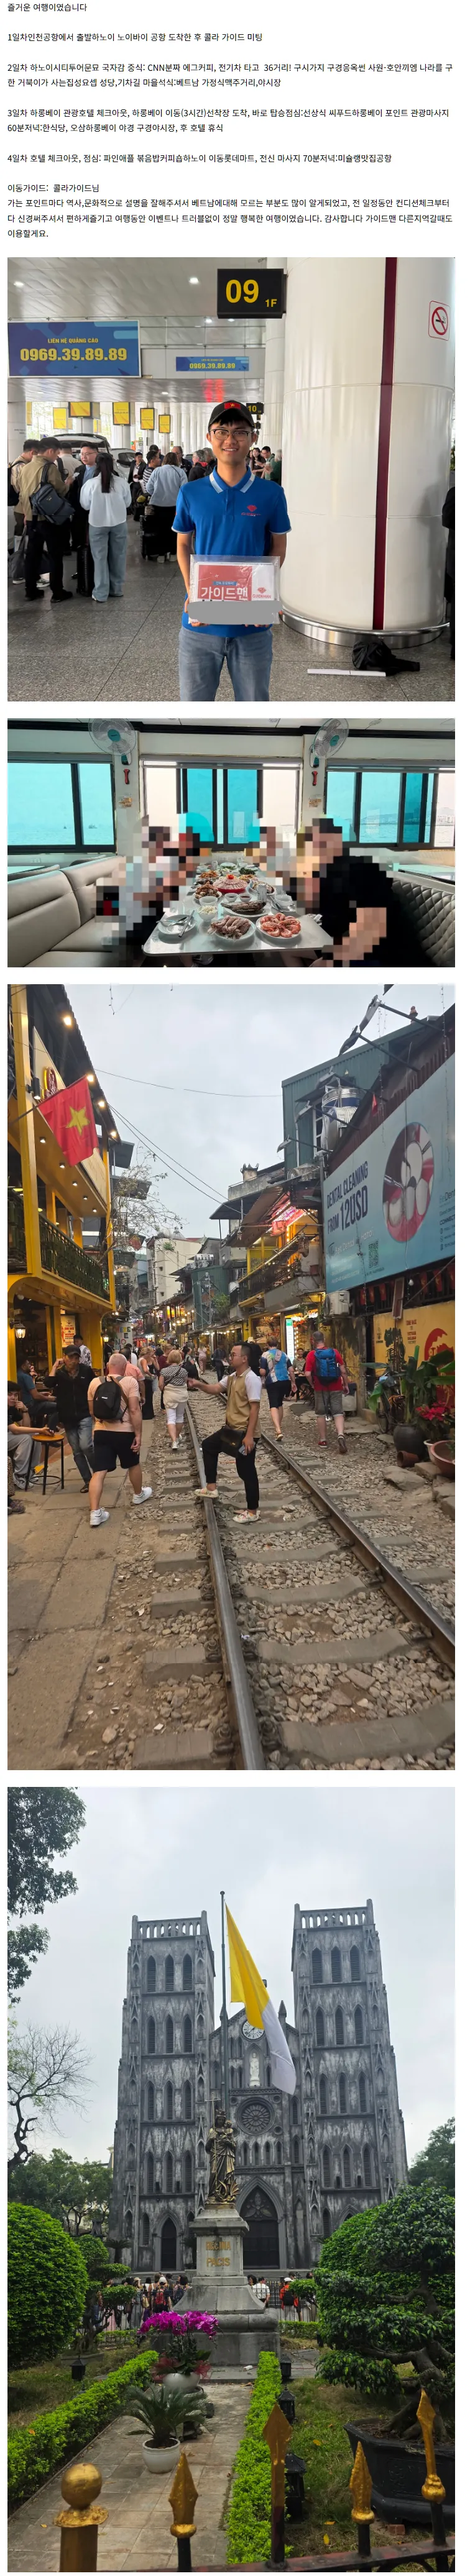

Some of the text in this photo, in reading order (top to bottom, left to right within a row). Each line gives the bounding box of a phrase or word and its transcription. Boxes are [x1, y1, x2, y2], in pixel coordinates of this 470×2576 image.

[226, 279, 277, 308] 09 1F
[20, 347, 127, 361] 0969.39.89.89
[201, 586, 248, 601] 가이드맨
[326, 1161, 368, 1209] DENTAL CLEANING
[327, 1185, 368, 1235] FROM 12USD
[343, 1237, 355, 1251] Dental
[361, 1227, 374, 1241] Hanoi
[206, 2241, 231, 2250] REGINA
[206, 2257, 231, 2267] PACIS
